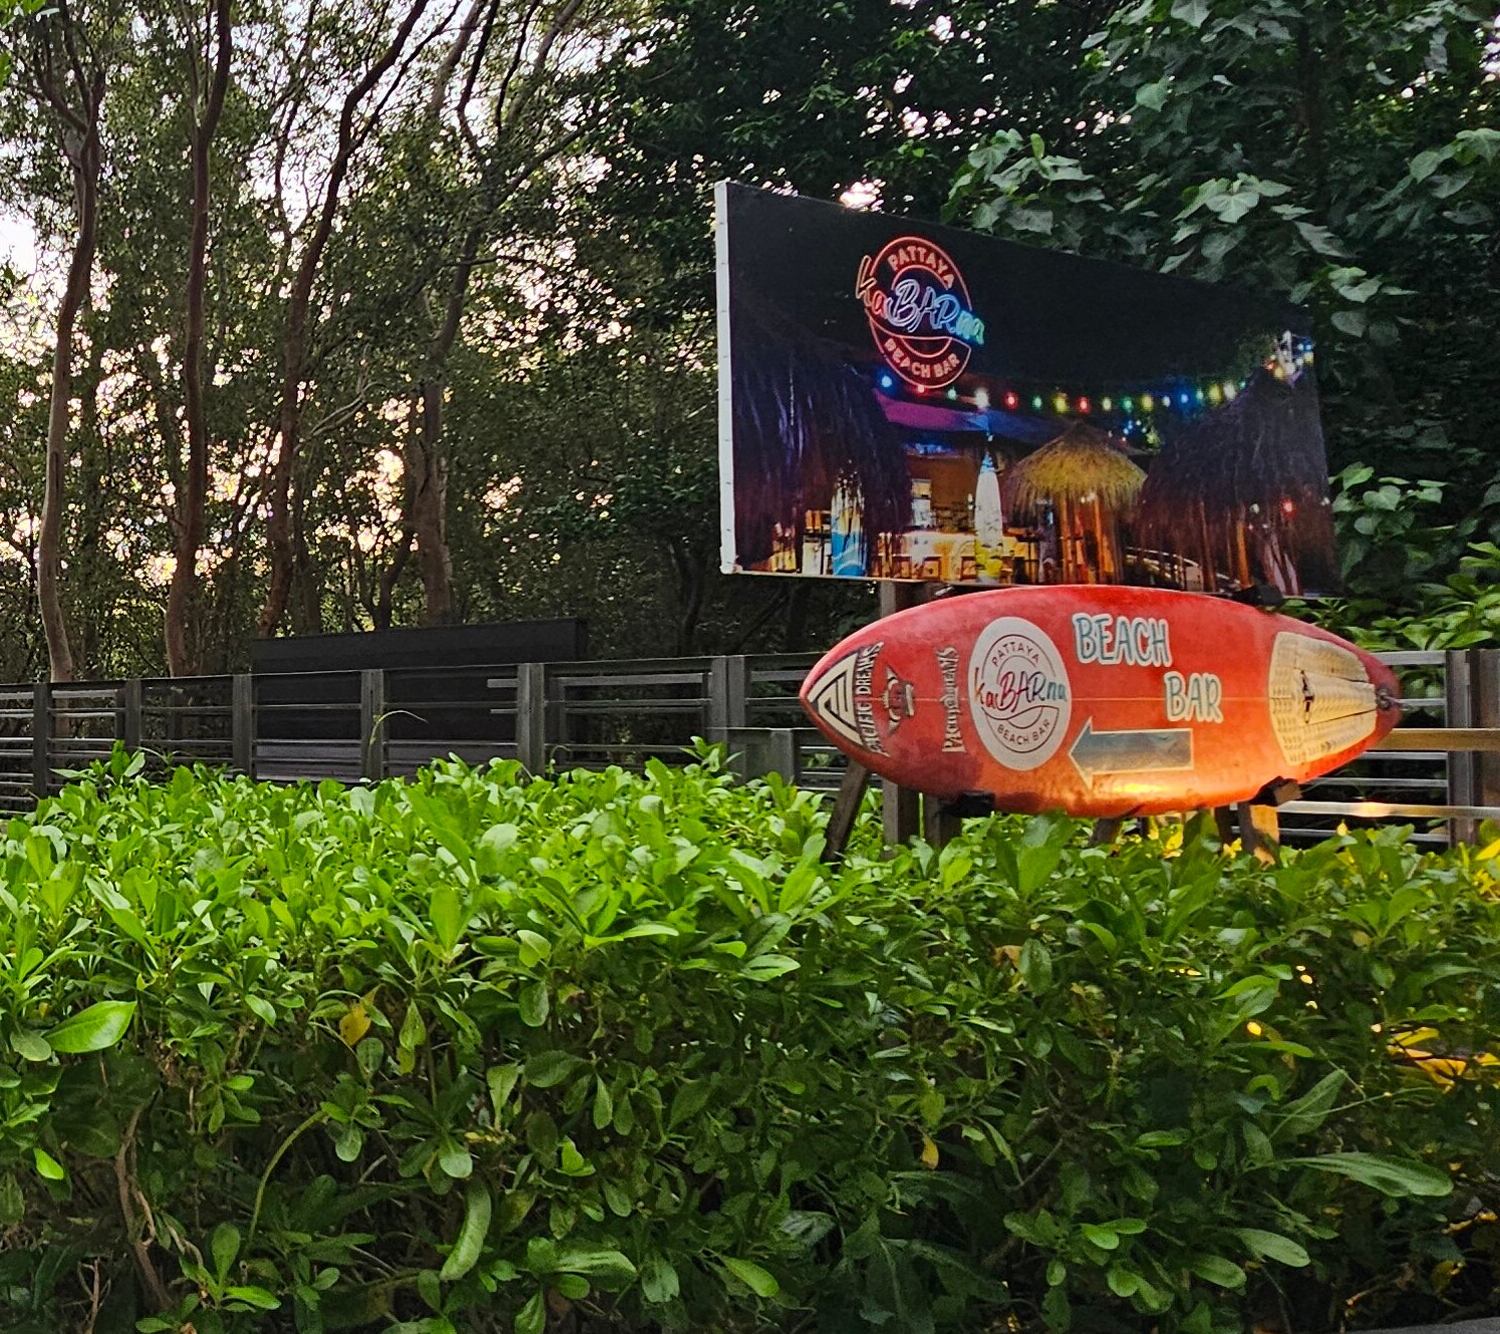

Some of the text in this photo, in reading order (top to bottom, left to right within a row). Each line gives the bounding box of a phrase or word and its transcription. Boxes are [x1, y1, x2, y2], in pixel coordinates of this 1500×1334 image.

[887, 245, 955, 289] PATTAYA
[884, 338, 960, 378] BEACH BAR
[991, 641, 1039, 667] PATTAYA
[1073, 614, 1171, 666] BEACH
[855, 641, 891, 758] PACIFIC DREAMS
[1164, 672, 1223, 723] BAR
[997, 718, 1050, 745] BEACH BAR
